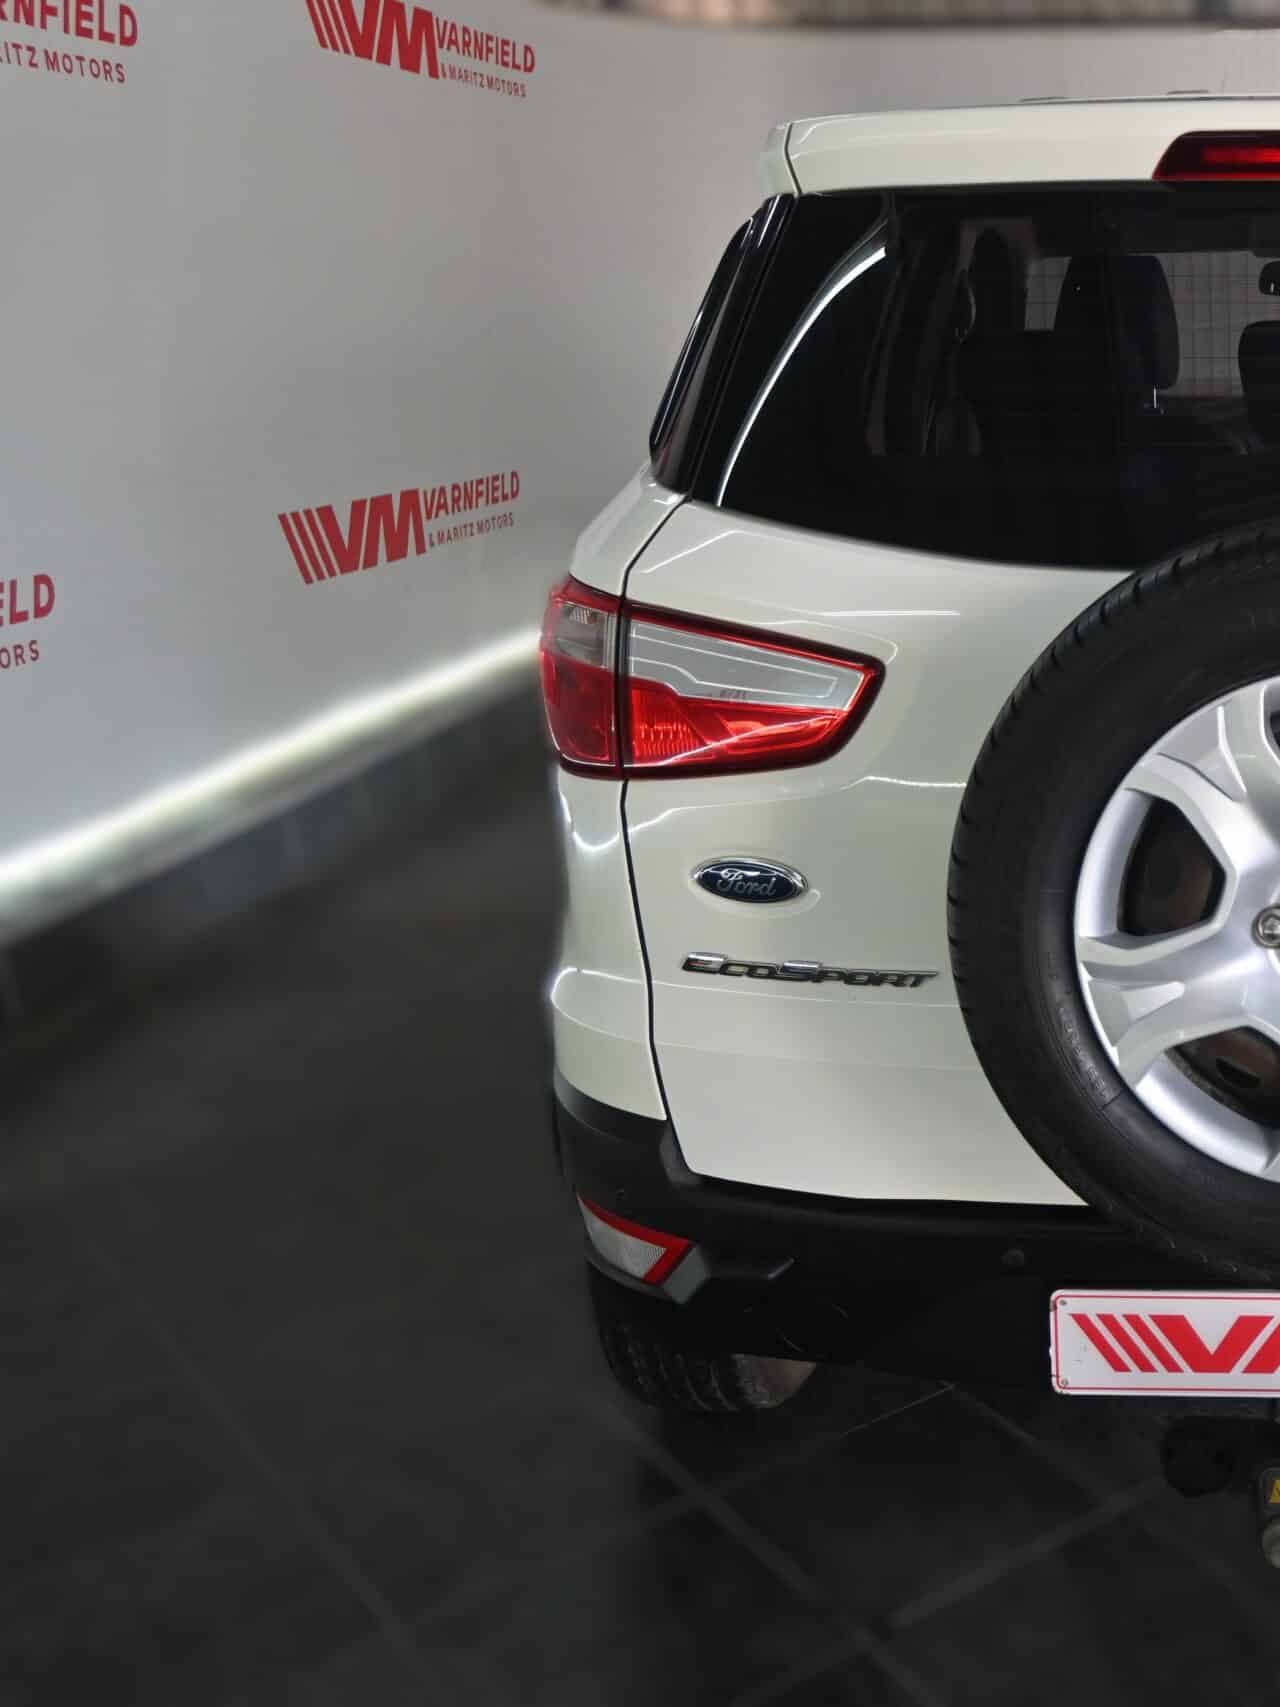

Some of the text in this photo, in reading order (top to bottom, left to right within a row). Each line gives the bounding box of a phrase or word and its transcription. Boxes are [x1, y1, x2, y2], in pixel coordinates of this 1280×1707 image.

[0, 0, 138, 47] NFIELD
[436, 16, 536, 73] VARNFIELD
[0, 41, 126, 83] ITZ MOTORS
[449, 64, 485, 88] MARITZ
[486, 74, 527, 98] MOTORS
[423, 470, 520, 520] VARNFIELD
[316, 488, 427, 575] VM
[429, 512, 514, 547] & MARITZ MOTORS
[0, 574, 55, 626] LD
[716, 867, 777, 896] Ford
